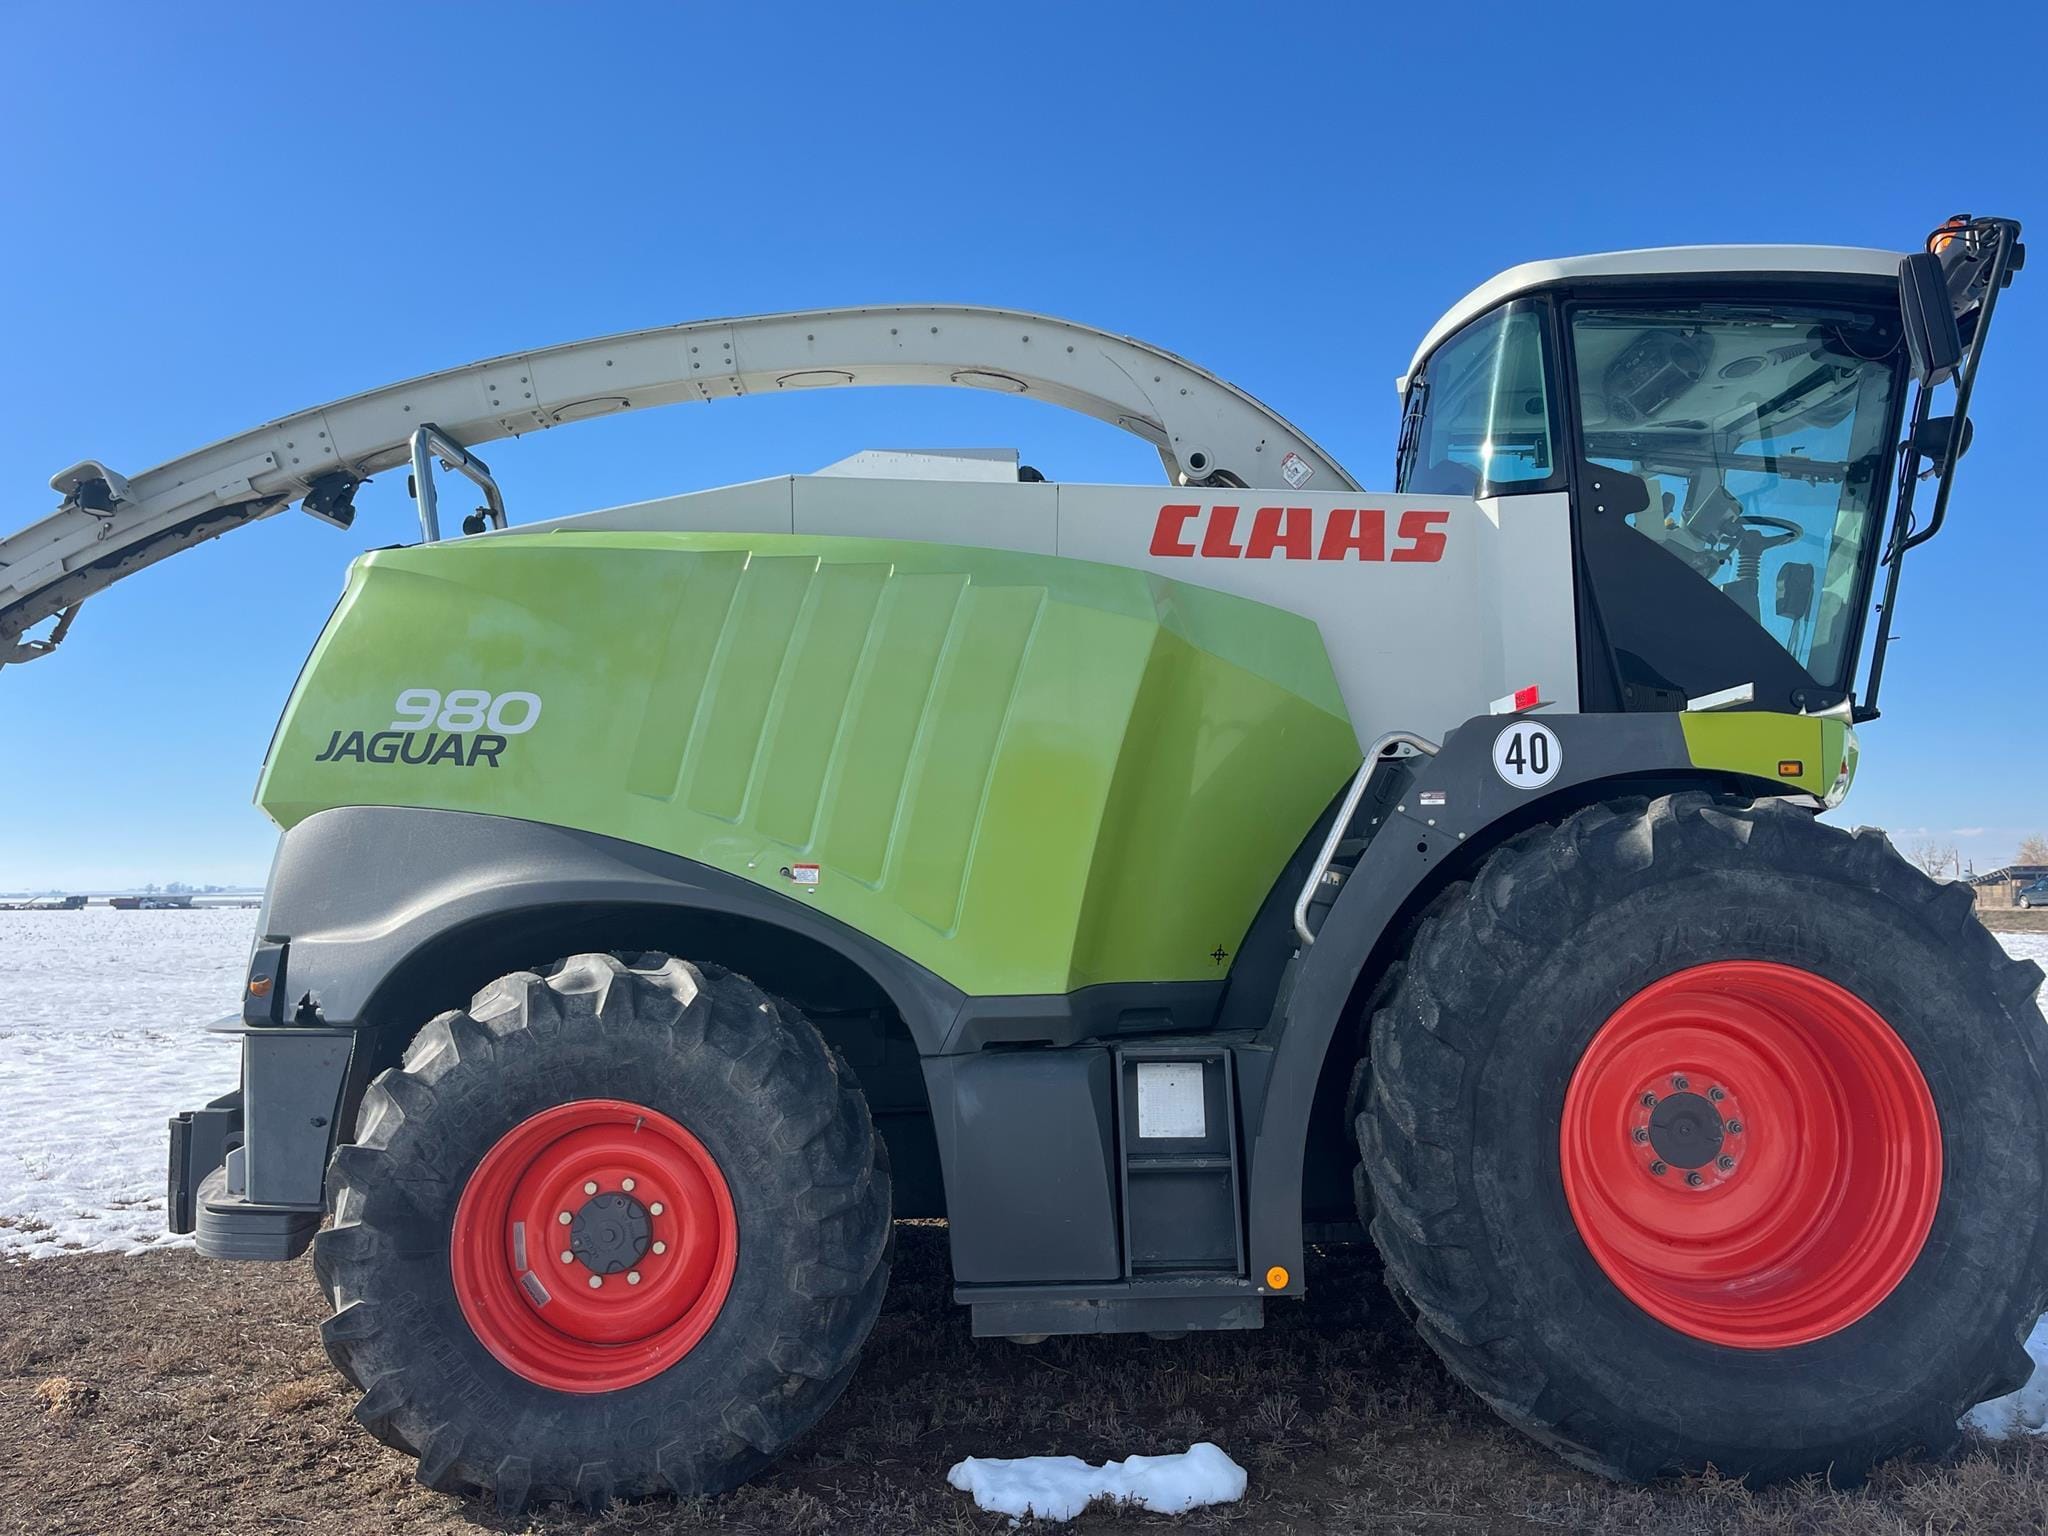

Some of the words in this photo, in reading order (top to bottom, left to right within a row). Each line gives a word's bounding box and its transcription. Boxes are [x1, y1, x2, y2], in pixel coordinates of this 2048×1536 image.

[1149, 504, 1450, 562] CLAAS
[390, 688, 542, 734] 980
[315, 731, 507, 767] JAGUAR
[1505, 732, 1548, 774] 40
